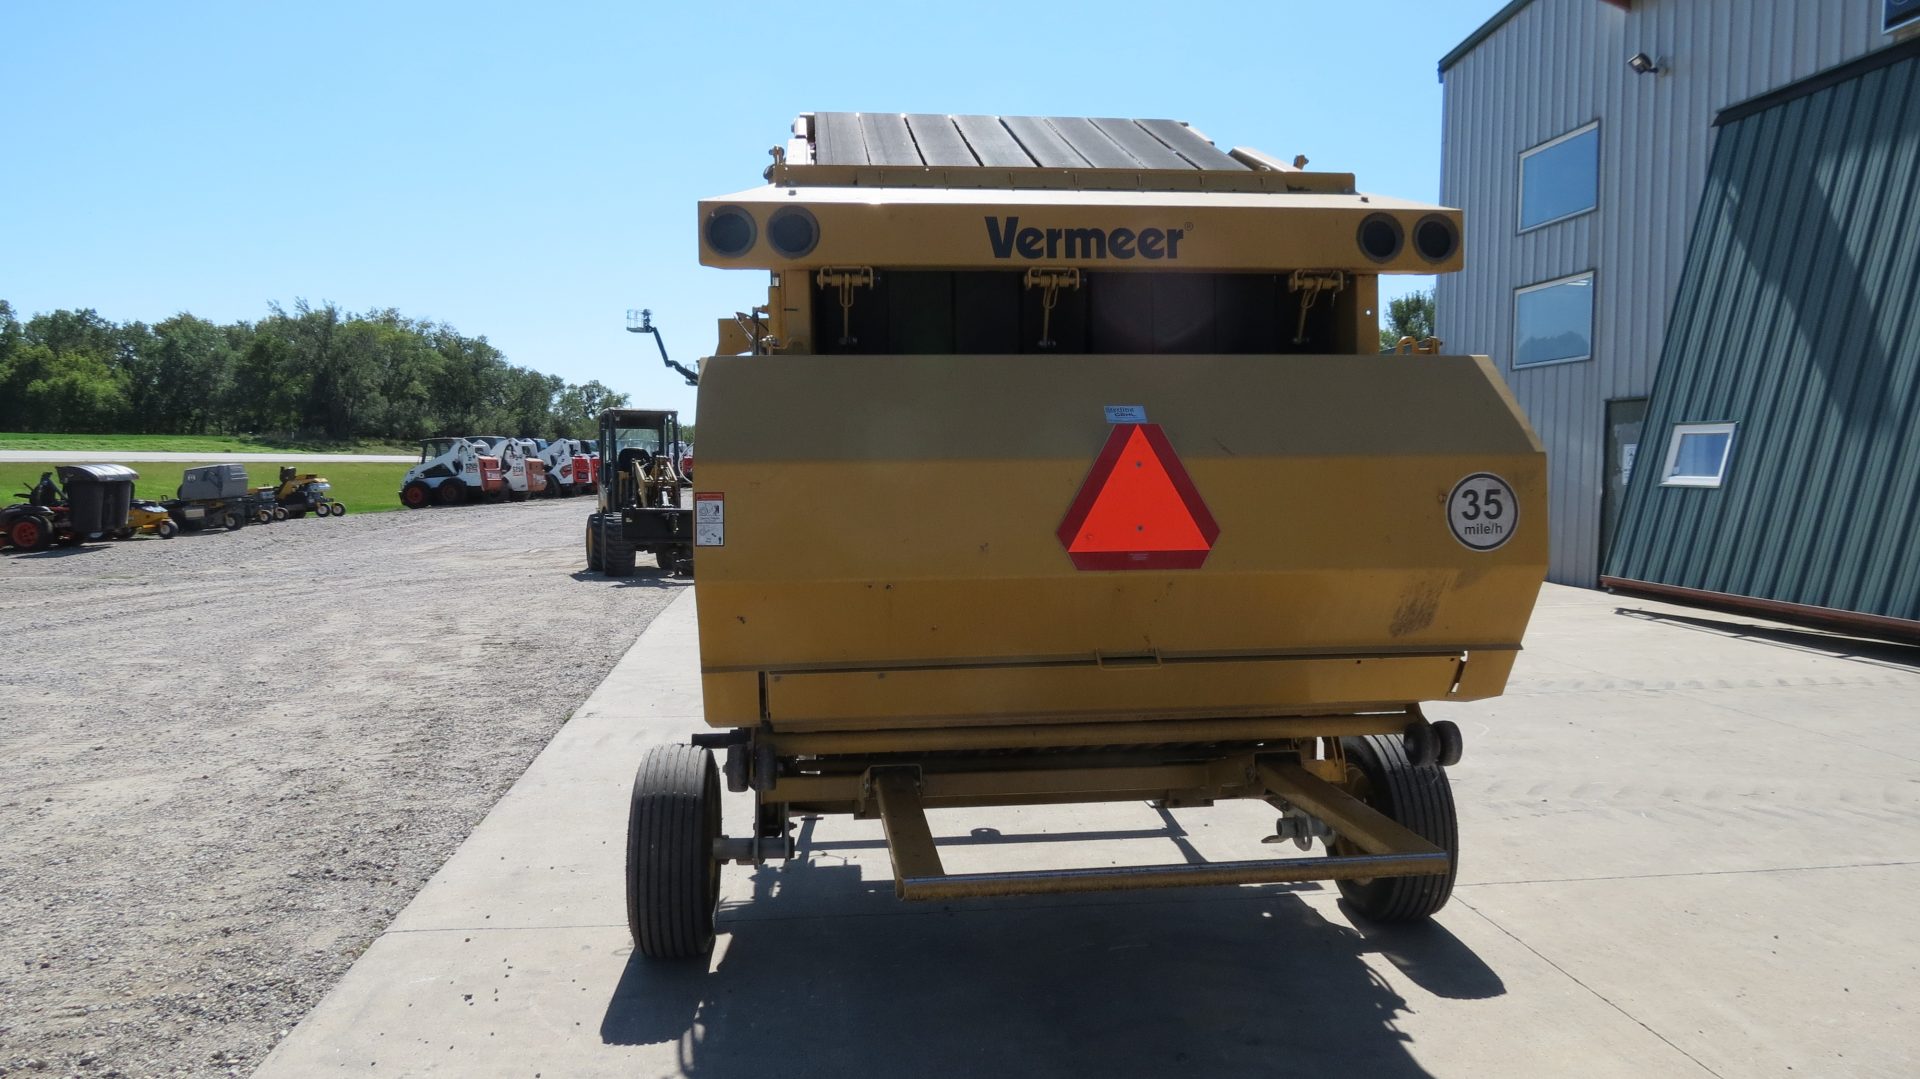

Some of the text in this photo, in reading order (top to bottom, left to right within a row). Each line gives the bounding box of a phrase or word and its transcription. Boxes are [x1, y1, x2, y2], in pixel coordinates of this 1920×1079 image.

[984, 216, 1184, 260] Vermeer
[1461, 488, 1503, 521] 35
[1464, 523, 1503, 535] mile/h
